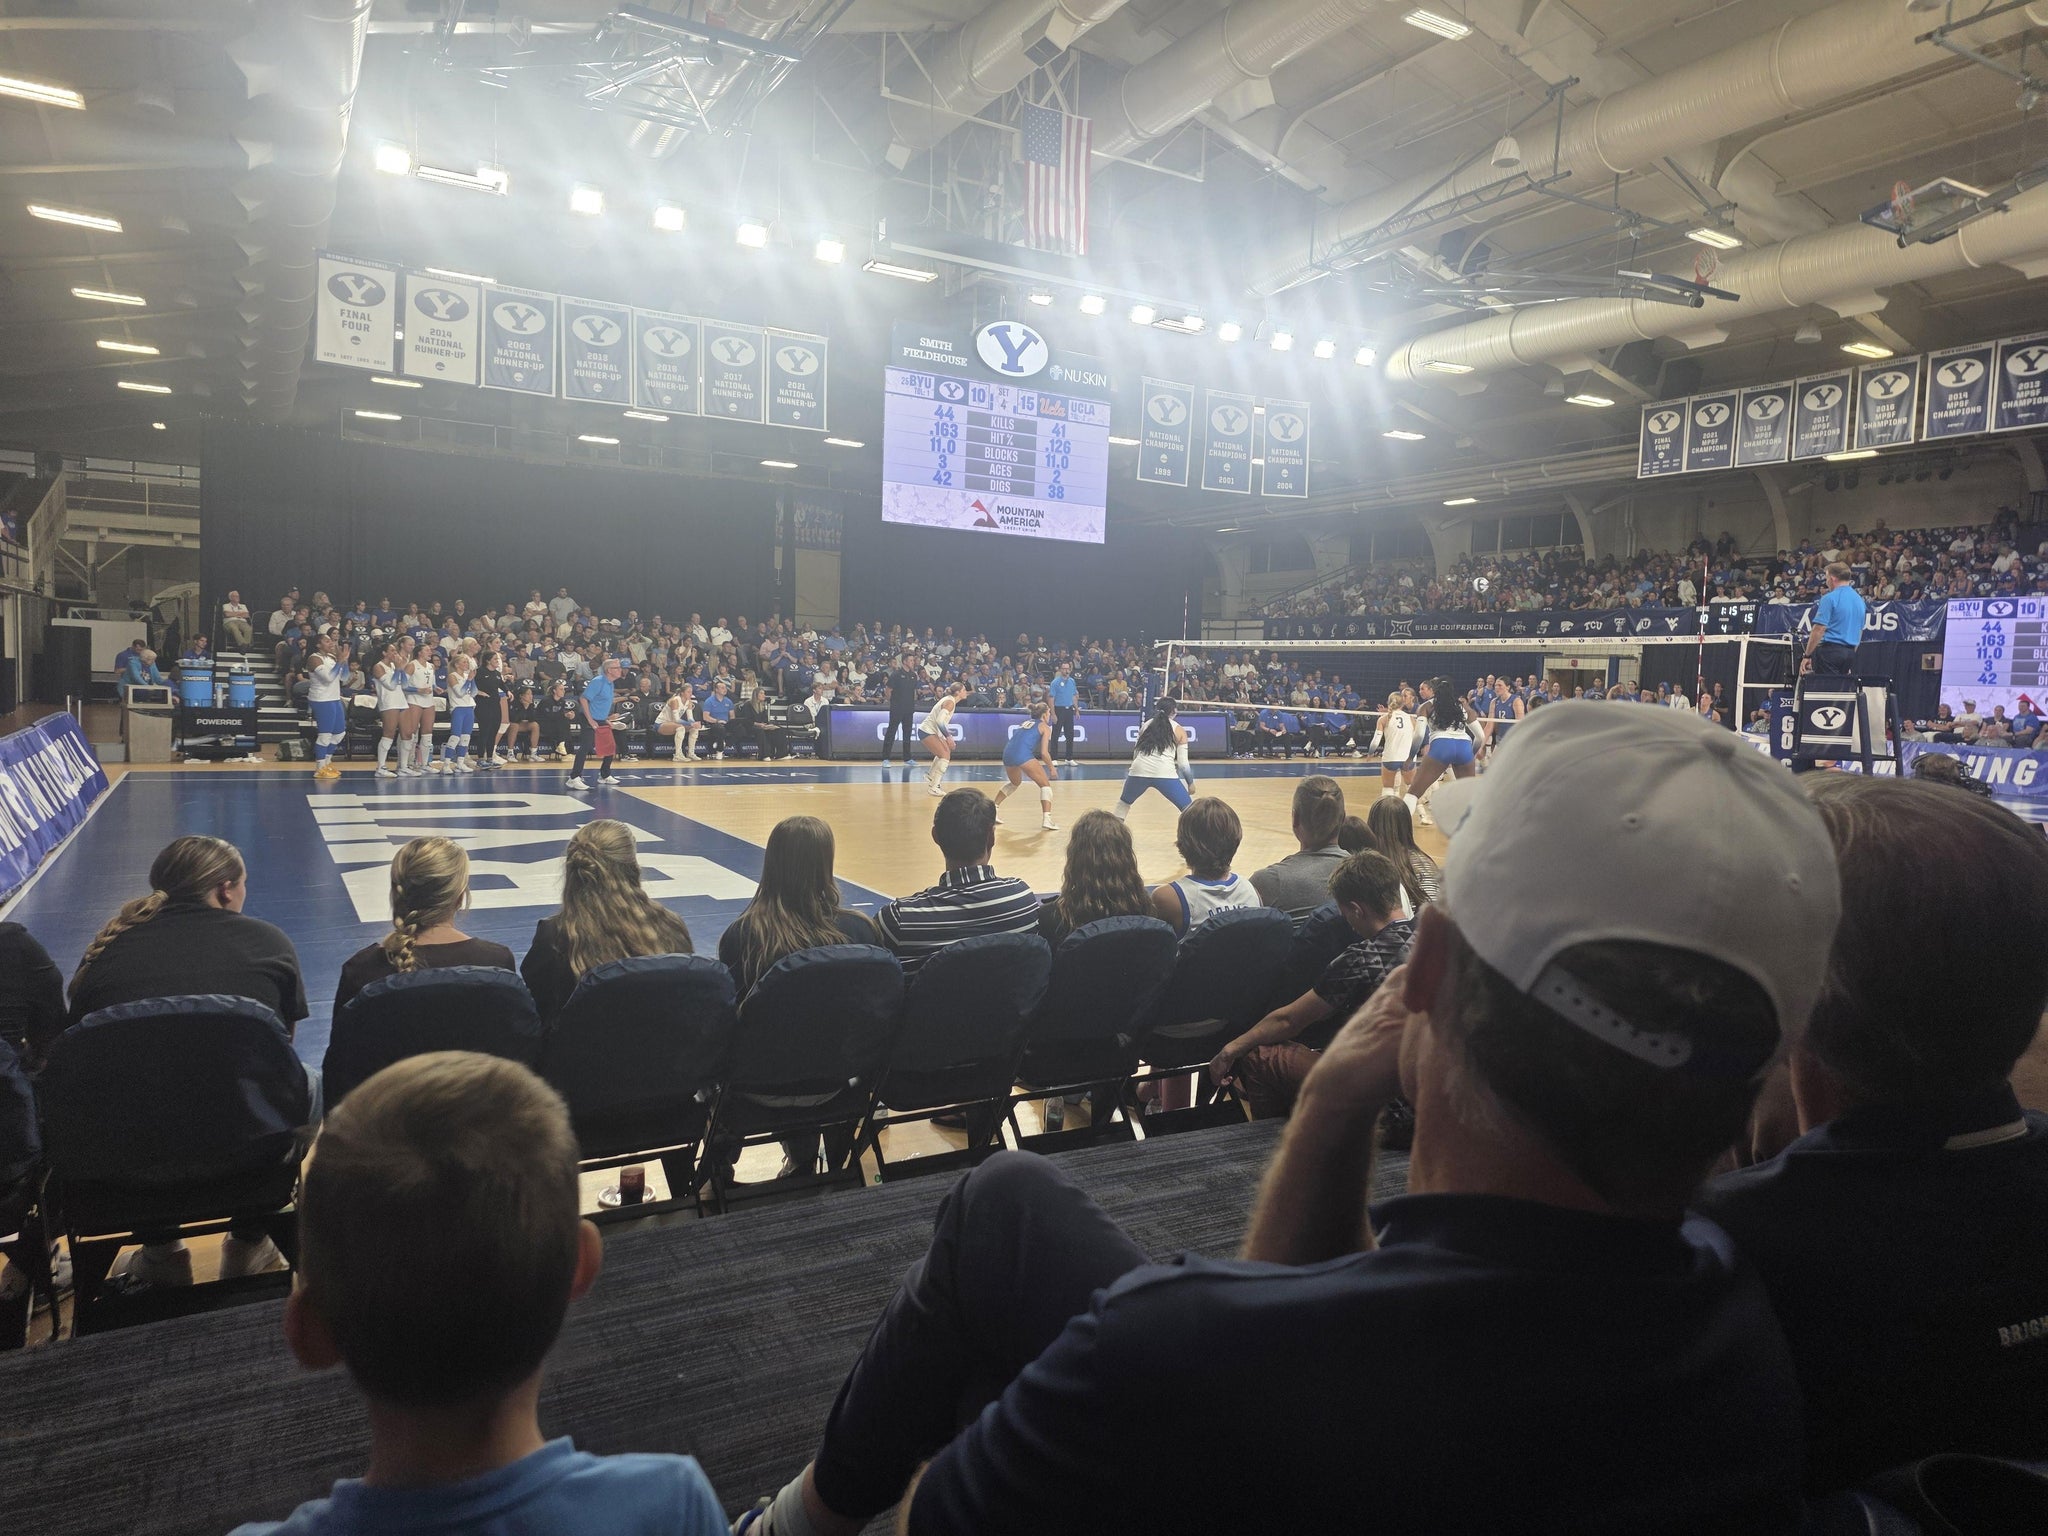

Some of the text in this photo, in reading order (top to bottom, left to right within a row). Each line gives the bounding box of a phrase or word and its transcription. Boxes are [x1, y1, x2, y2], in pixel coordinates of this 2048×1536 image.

[340, 308, 372, 322] FINAL
[341, 320, 370, 332] FOUR
[430, 328, 452, 338] 2014
[419, 336, 463, 349] NATIONAL
[919, 338, 952, 351] SMITH
[415, 345, 466, 359] RUNNER-UP
[497, 348, 541, 361] NATIONAL
[903, 347, 968, 366] FIELDHOUSE
[494, 357, 544, 371] RUNNER-UP
[576, 360, 618, 372] NATIONAL
[574, 369, 622, 381] RUNNER-UP
[648, 371, 687, 382] NATIONAL
[724, 372, 742, 381] 2017
[1064, 368, 1107, 387] NU SKIN
[645, 379, 689, 391] RUNNER-UP
[715, 380, 751, 391] NATIONAL
[787, 381, 806, 390] 2021
[910, 375, 932, 389] BYU
[712, 388, 753, 400] RUNNER-UP
[780, 389, 814, 400] NATIONAL
[971, 388, 985, 403] 10
[999, 388, 1009, 397] SET
[1948, 392, 1968, 401] 2014
[2017, 388, 2041, 399] MPSF
[777, 397, 816, 408] RUNNER-UP
[1000, 399, 1006, 410] 4
[1020, 395, 1034, 411] 15
[1946, 400, 1969, 409] MPSF
[934, 405, 955, 421] 44
[1070, 403, 1095, 416] UCLA
[1875, 411, 1896, 420] MPSF
[1933, 406, 1981, 419] CHAMPIONS
[991, 416, 1014, 430] KILLS
[1813, 415, 1829, 423] 2017
[1863, 417, 1908, 430] CHAMPIONS
[929, 422, 958, 438] .163
[1052, 423, 1066, 438] 41
[1812, 422, 1831, 430] MPSF
[990, 432, 1014, 446] HIT %
[1150, 431, 1181, 443] NATIONAL
[1754, 432, 1772, 440] MPSF
[1801, 428, 1840, 440] CHAMPIONS
[930, 437, 956, 454] 11.0
[1045, 439, 1071, 454] .126
[1145, 439, 1184, 451] CHAMPIONS
[1213, 441, 1244, 451] NATIONAL
[1655, 437, 1671, 445] FINAL
[1701, 438, 1719, 446] MPSF
[1744, 437, 1782, 448] CHAMPIONS
[984, 447, 1018, 462] BLOCKS
[1209, 449, 1247, 460] CHAMPIONS
[1271, 448, 1300, 457] NATIONAL
[1691, 444, 1728, 454] CHAMPIONS
[939, 454, 947, 469] 3
[1045, 454, 1069, 469] 11.0
[1268, 456, 1303, 465] CHAMPIONS
[989, 464, 1012, 477] ACES
[933, 470, 952, 486] 42
[1053, 470, 1061, 484] 2
[1219, 476, 1234, 484] 2001
[990, 479, 1011, 493] DIGS
[1048, 484, 1064, 499] 38
[1277, 481, 1293, 490] 2004
[997, 505, 1044, 519] MOUNTAIN
[999, 517, 1041, 528] AMERICA
[1959, 602, 1979, 611] BYU
[2021, 602, 2036, 614] 10
[1700, 614, 1708, 624] 10
[1744, 613, 1753, 623] 15
[1440, 623, 1494, 631] CONFERENCE
[1584, 621, 1603, 630] TCU
[1721, 624, 1727, 633] 4
[1982, 621, 2002, 633] 44
[1976, 634, 2005, 646] .163
[1977, 647, 2002, 659] 11.0
[1984, 660, 1993, 671] 3
[426, 676, 429, 684] 7
[1978, 673, 1997, 684] 42
[1396, 717, 1403, 729] 3
